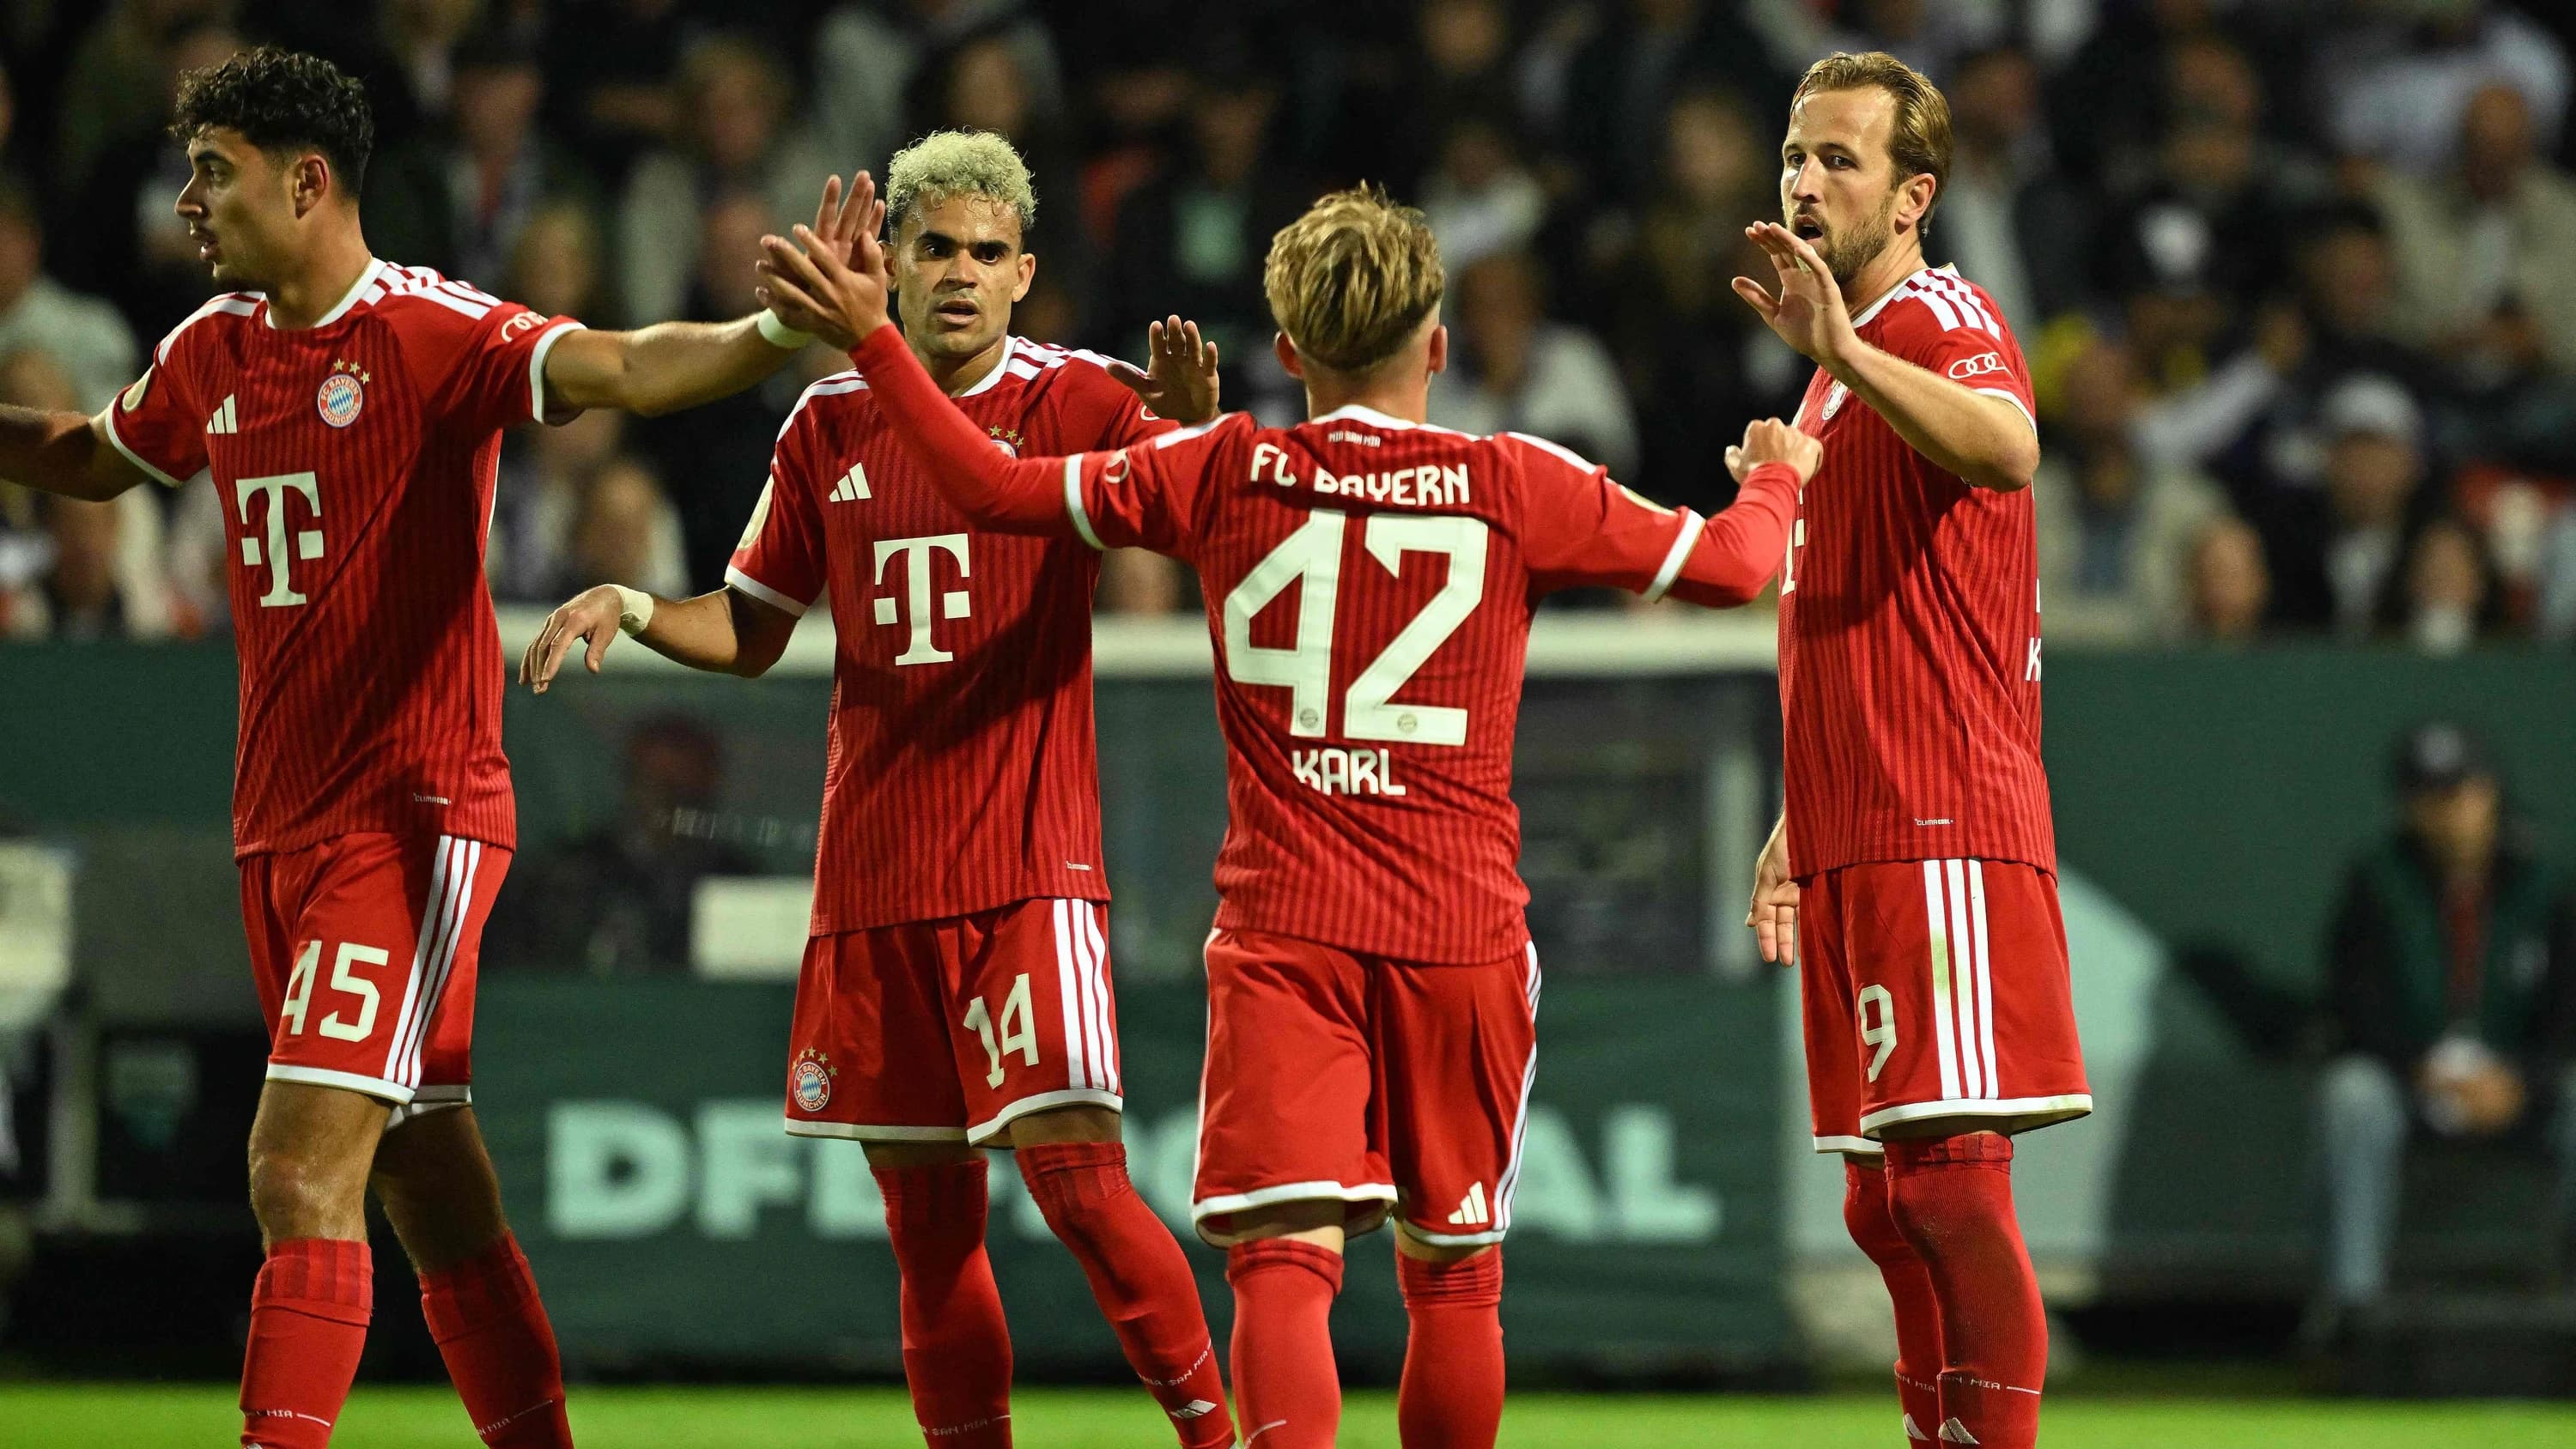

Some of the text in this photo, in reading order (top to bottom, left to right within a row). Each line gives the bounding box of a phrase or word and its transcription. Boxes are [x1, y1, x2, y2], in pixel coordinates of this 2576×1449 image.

[1250, 442, 1470, 506] FC BAYERN
[1224, 508, 1489, 747] 42
[1291, 748, 1406, 797] KARL
[281, 939, 389, 1042] 45
[963, 973, 1039, 1090] 14
[1857, 984, 1897, 1082] 9
